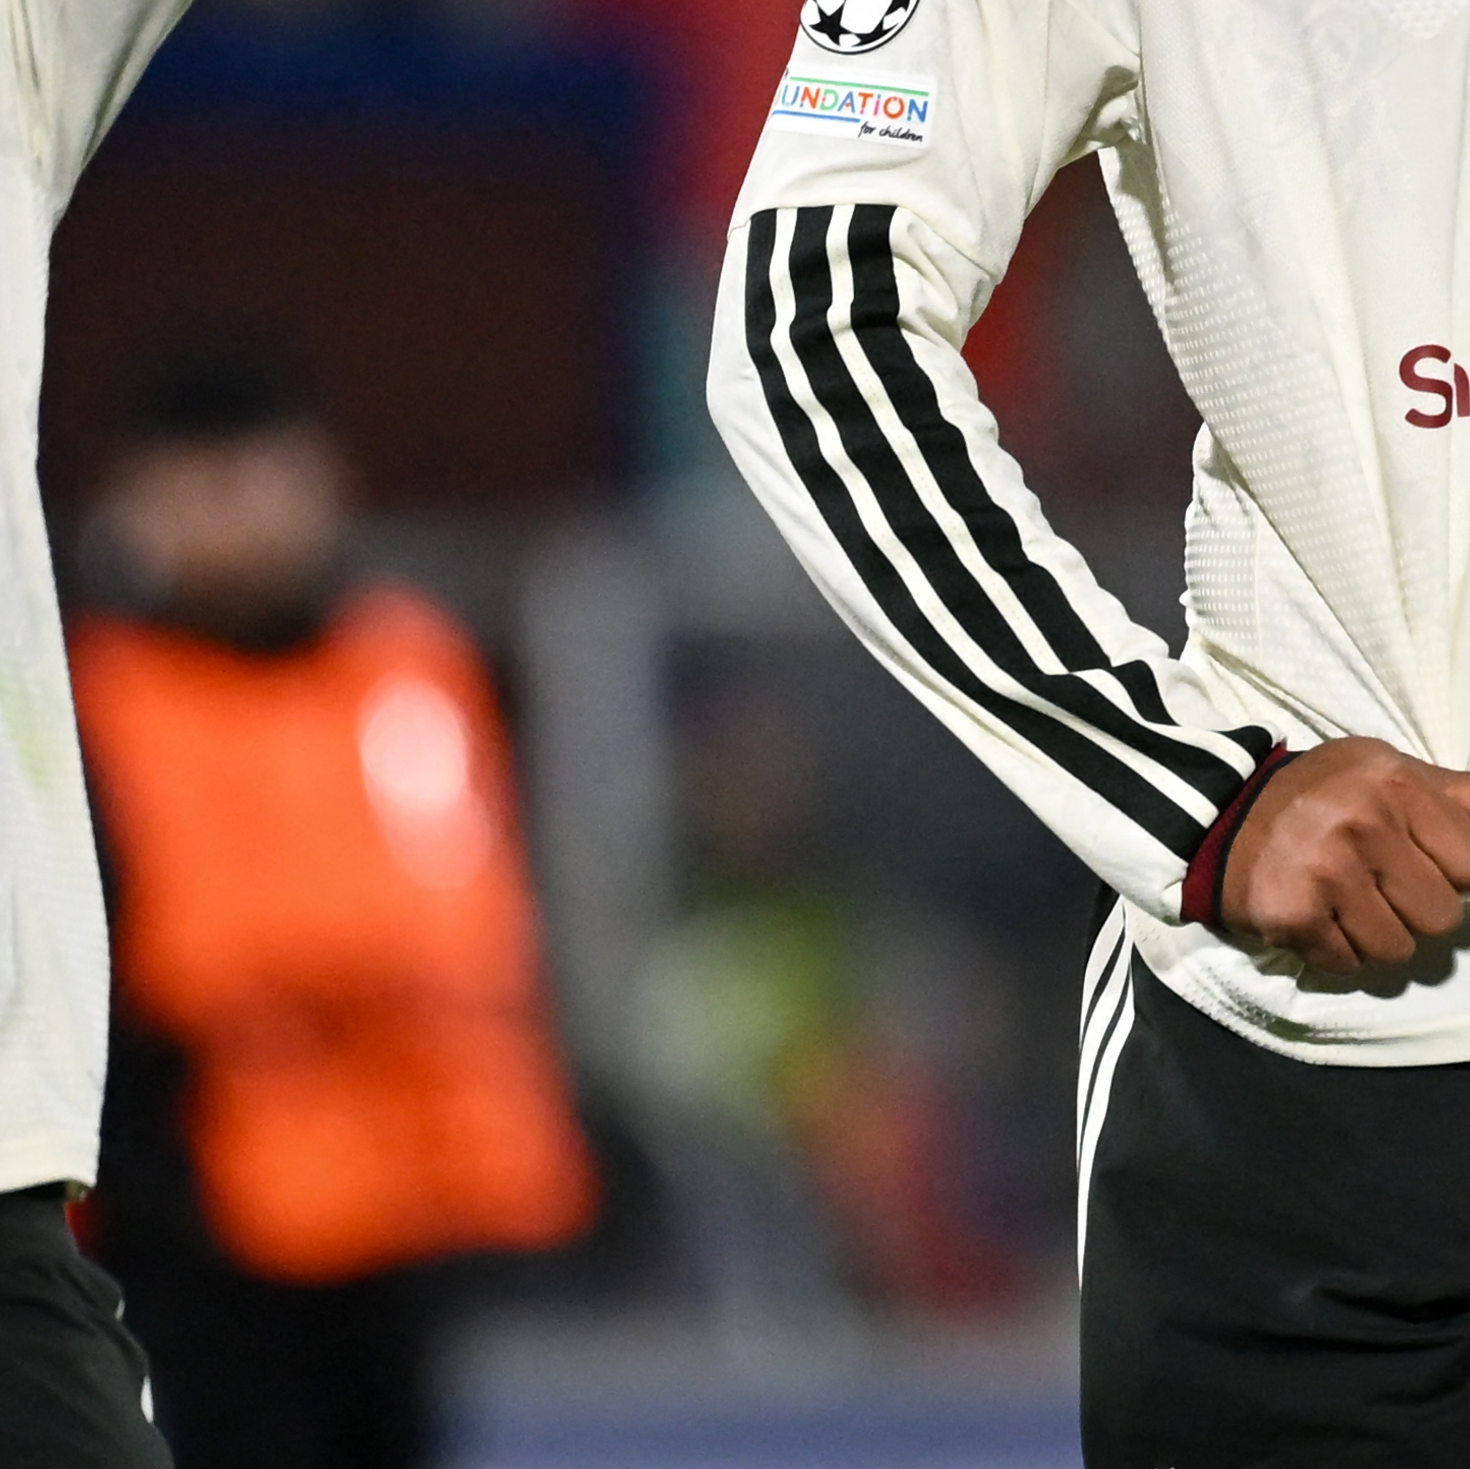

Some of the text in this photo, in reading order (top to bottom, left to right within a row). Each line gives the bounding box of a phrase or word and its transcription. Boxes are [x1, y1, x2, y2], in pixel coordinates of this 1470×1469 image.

[778, 85, 929, 122] UNDATION
[858, 122, 923, 142] for children
